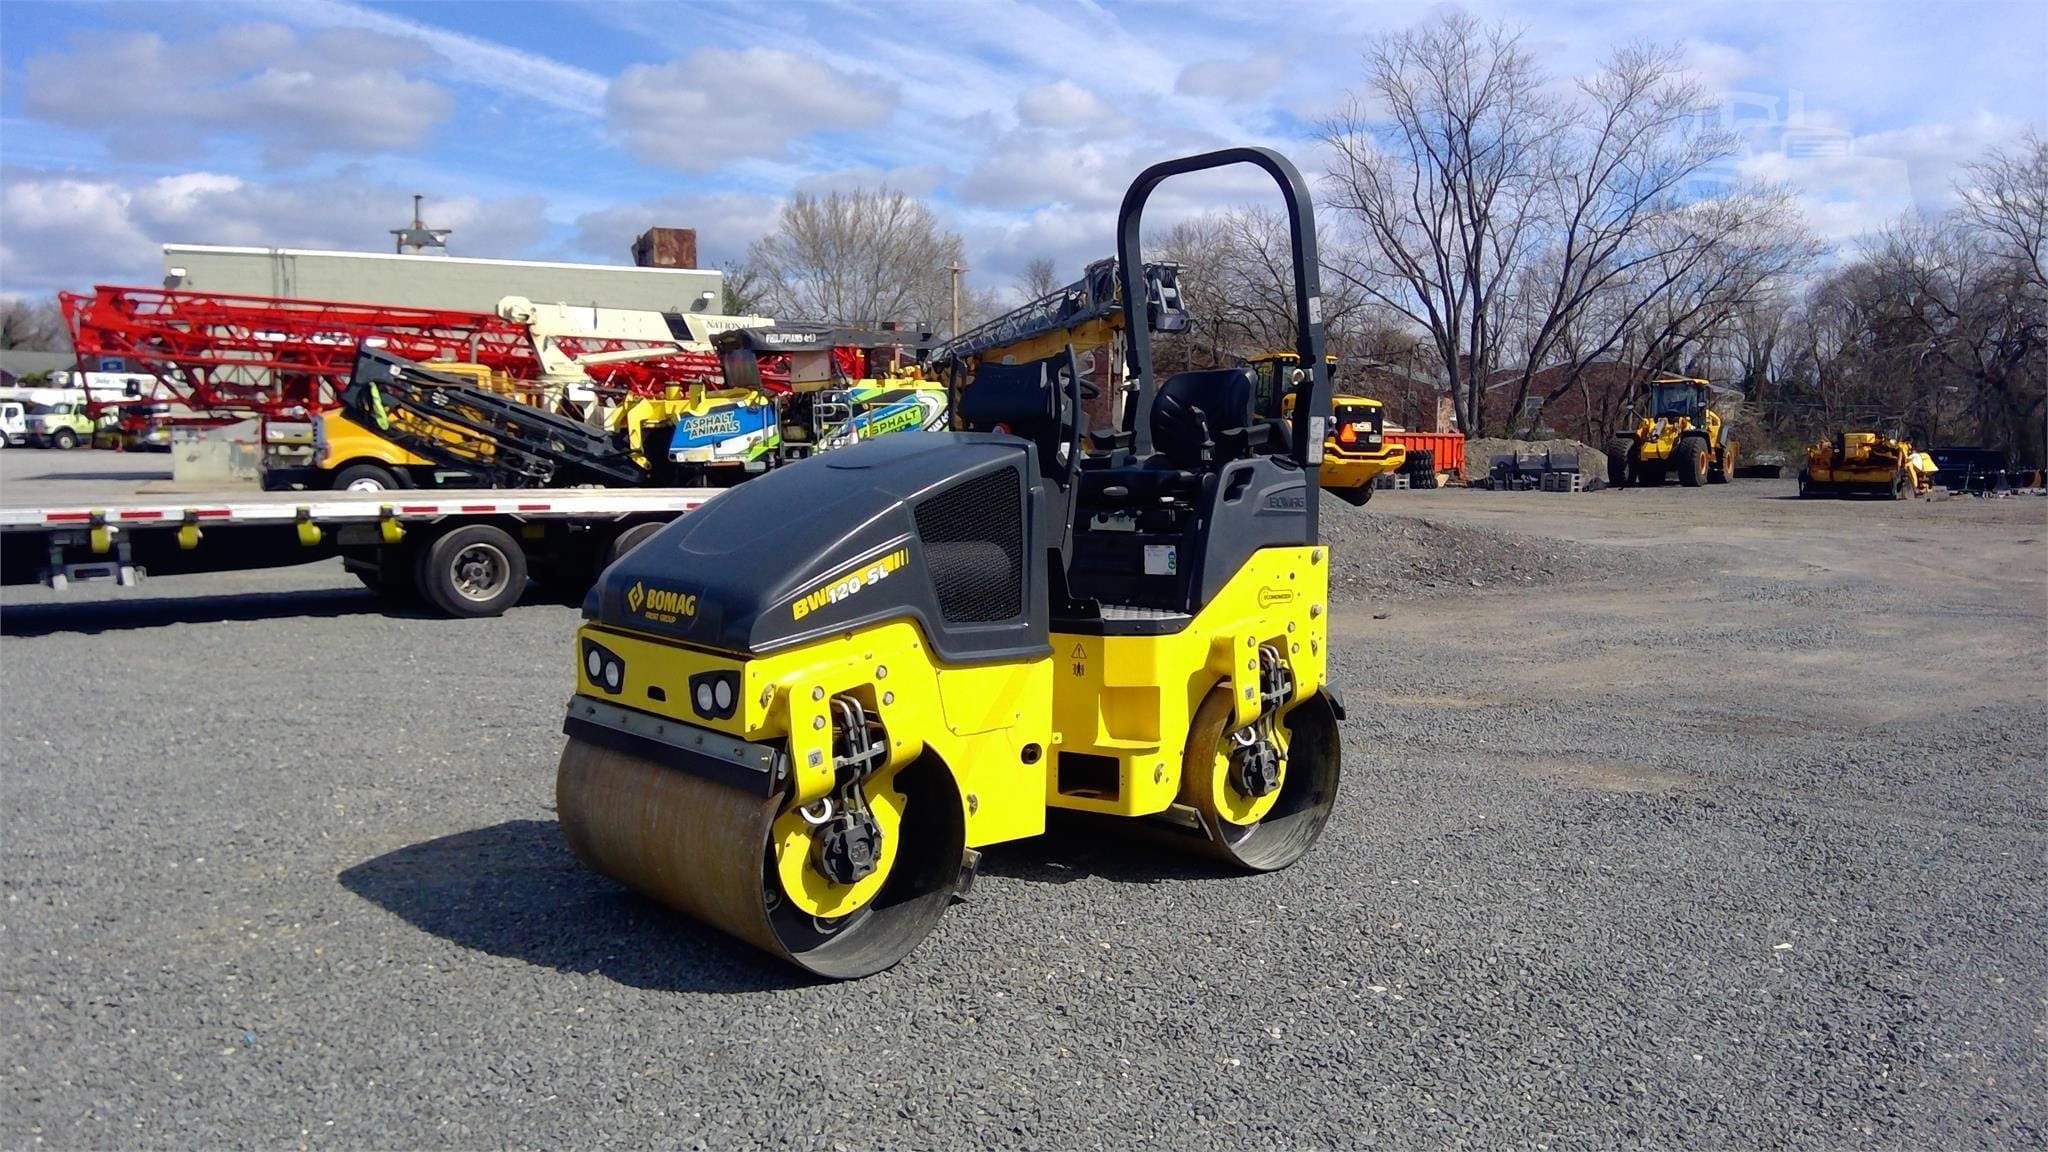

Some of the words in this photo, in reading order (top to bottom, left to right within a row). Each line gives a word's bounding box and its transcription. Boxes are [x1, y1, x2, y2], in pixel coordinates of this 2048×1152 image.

[684, 413, 733, 431] ASPHALT
[690, 421, 739, 439] ANIMALS
[863, 409, 918, 438] ASPHALT
[867, 565, 889, 586] SL
[646, 588, 697, 617] BOMAG
